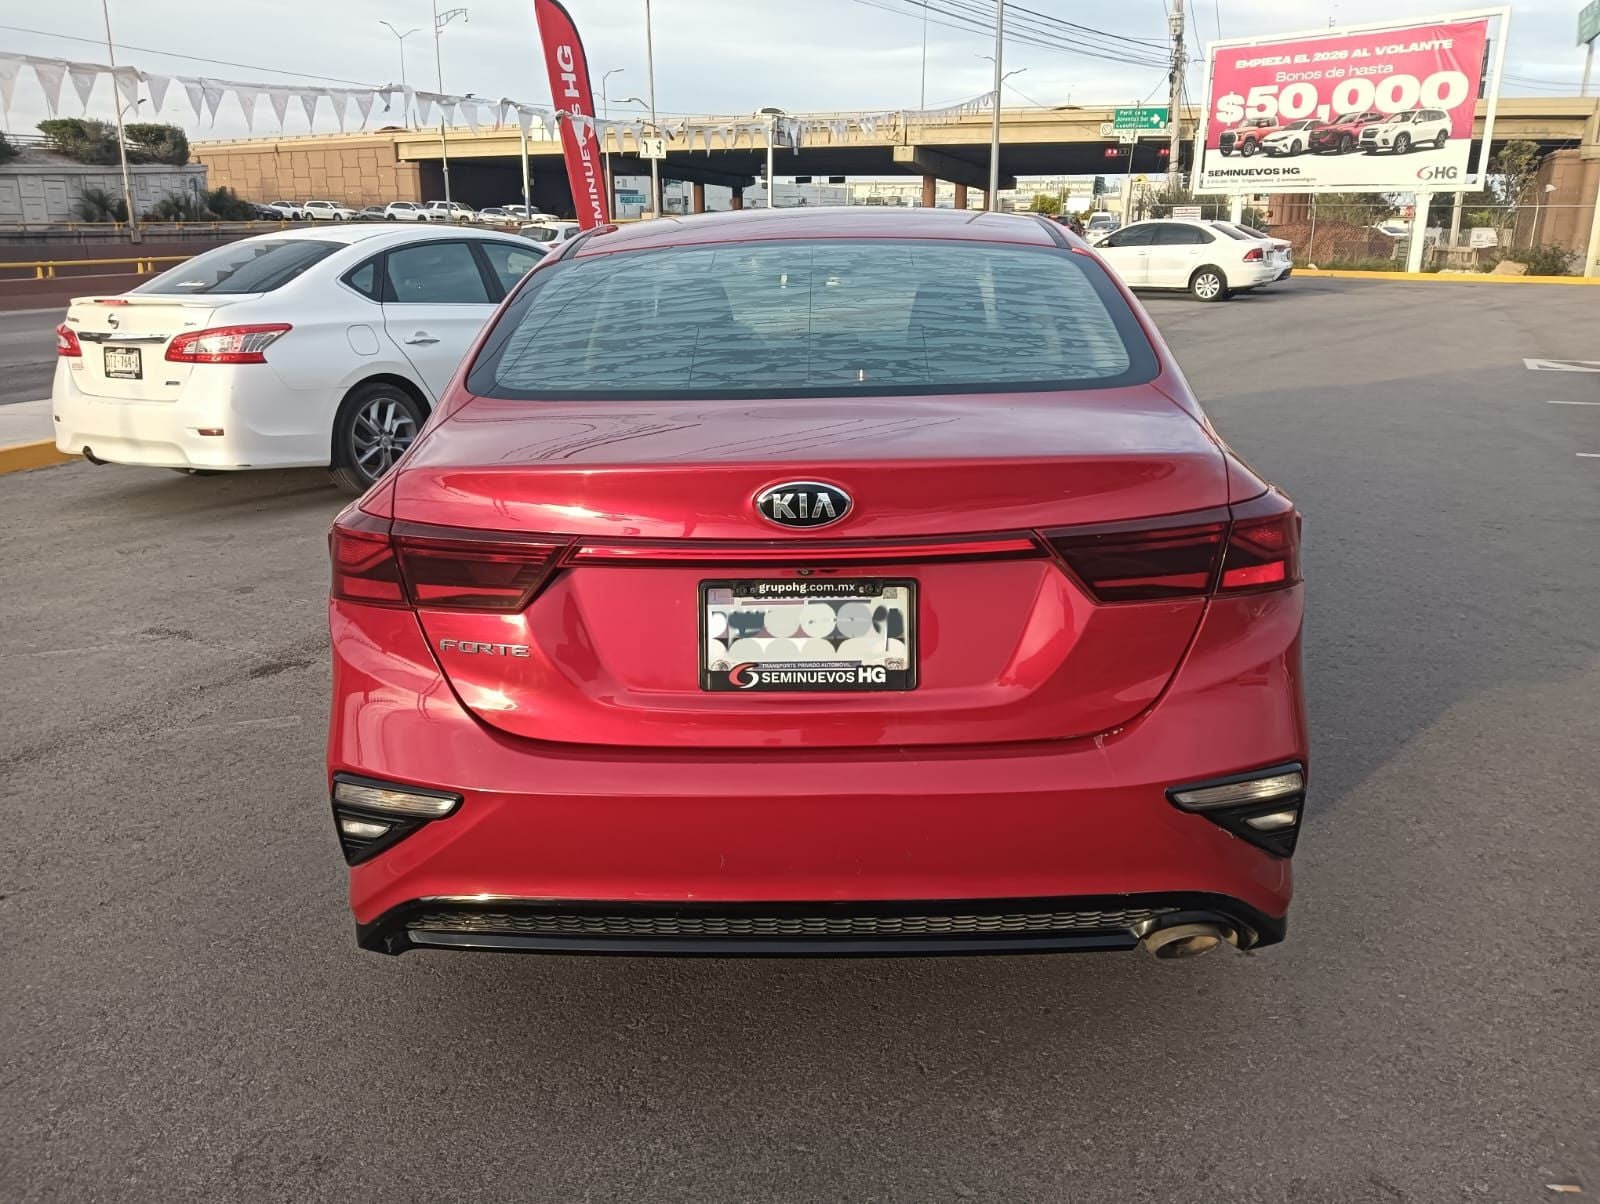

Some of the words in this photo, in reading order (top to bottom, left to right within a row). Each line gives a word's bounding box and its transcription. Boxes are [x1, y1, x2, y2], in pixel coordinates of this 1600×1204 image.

[1235, 55, 1291, 69] EMPIEZA
[1294, 54, 1312, 64] EL
[1312, 50, 1348, 62] 2026
[1348, 48, 1371, 59] AL
[1375, 39, 1455, 56] VOLANTE
[556, 44, 581, 99] HG
[1275, 67, 1322, 83] Bonos
[1325, 65, 1346, 78] de
[1348, 62, 1394, 76] hasta
[1215, 70, 1470, 126] $50,000
[1207, 168, 1280, 177] SEMINUEVOS
[1282, 167, 1301, 175] HG
[1433, 165, 1458, 179] HG
[772, 491, 838, 519] KIA
[758, 581, 855, 594] grupohg.com.mx
[439, 639, 531, 657] FORTE
[761, 671, 855, 684] SEMINUEVOS
[858, 667, 887, 683] HG
